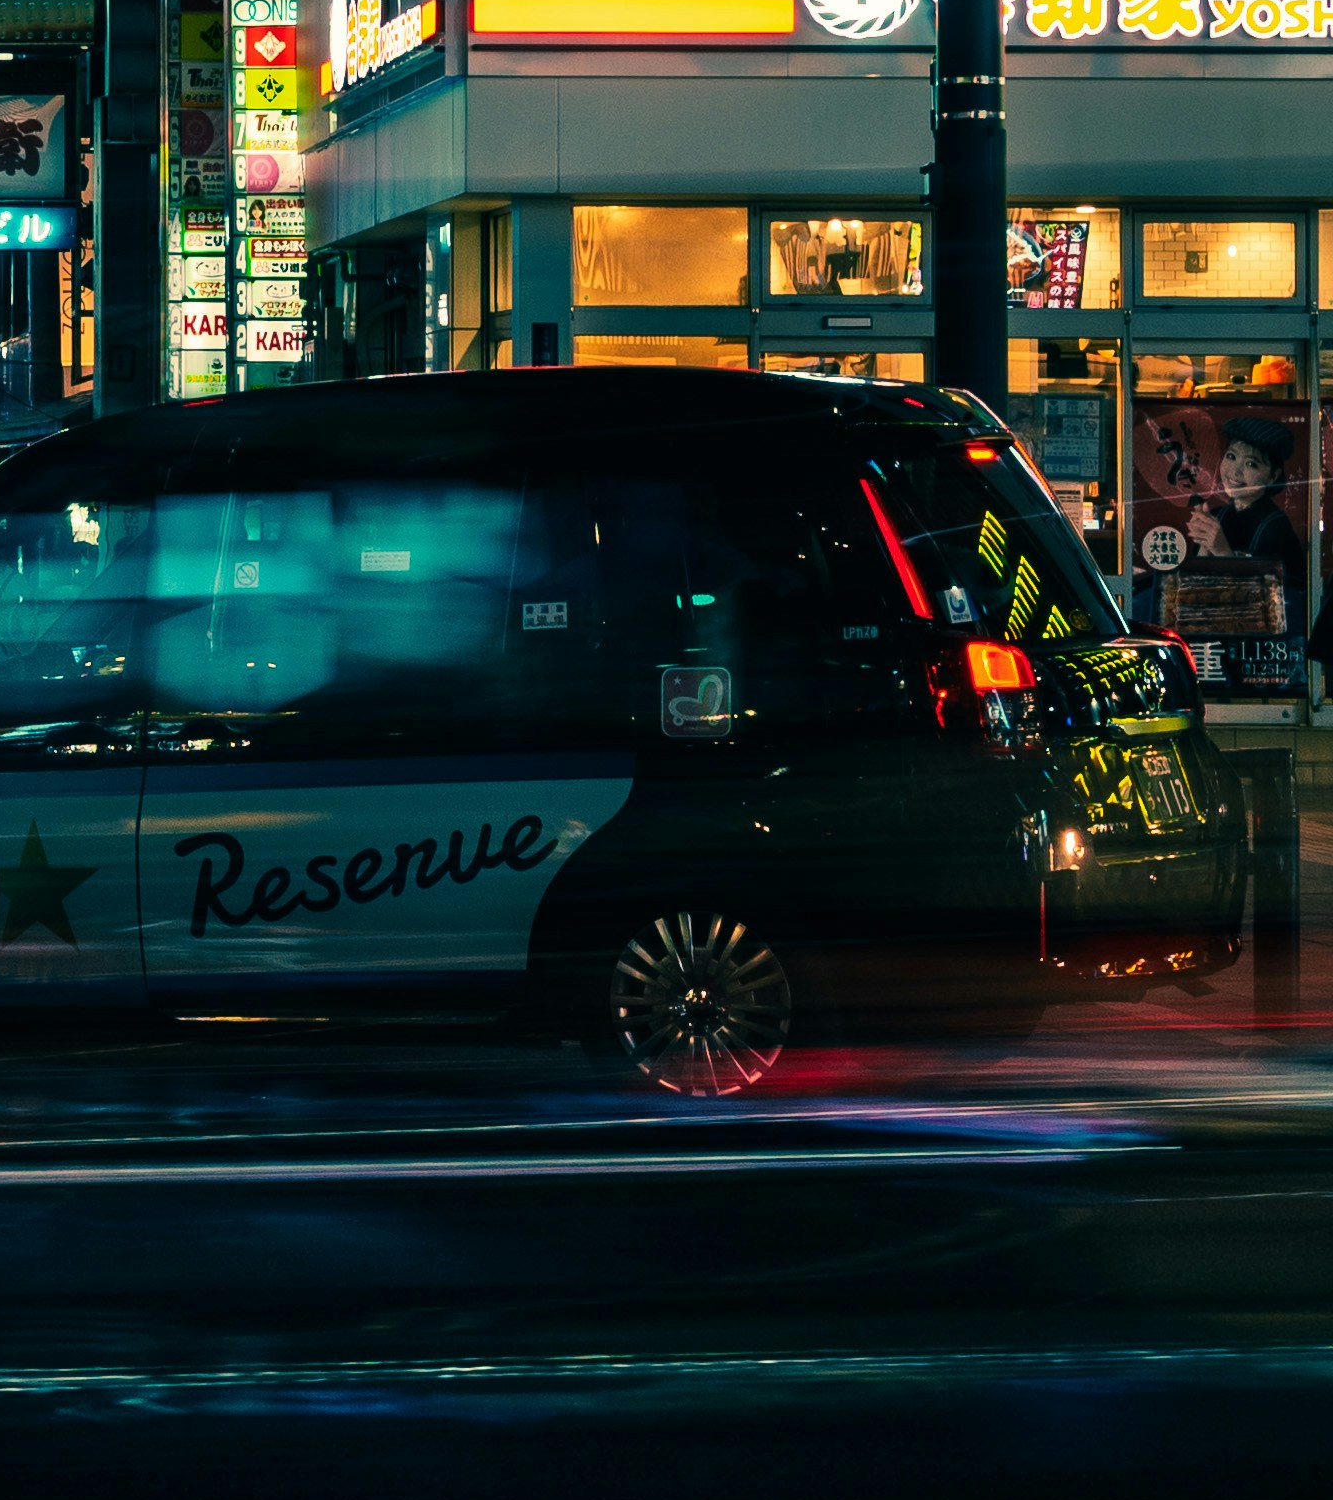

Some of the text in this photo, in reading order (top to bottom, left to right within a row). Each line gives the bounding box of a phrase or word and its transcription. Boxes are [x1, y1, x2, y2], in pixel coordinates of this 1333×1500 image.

[235, 29, 246, 64] 9
[235, 71, 246, 106] 8
[235, 117, 245, 148] 7
[235, 155, 246, 190] 6
[235, 198, 247, 232] 5
[235, 240, 247, 274] 4
[235, 280, 247, 316] 3
[184, 314, 226, 337] KAR
[235, 323, 247, 359] 2
[174, 813, 559, 938] Reserve
